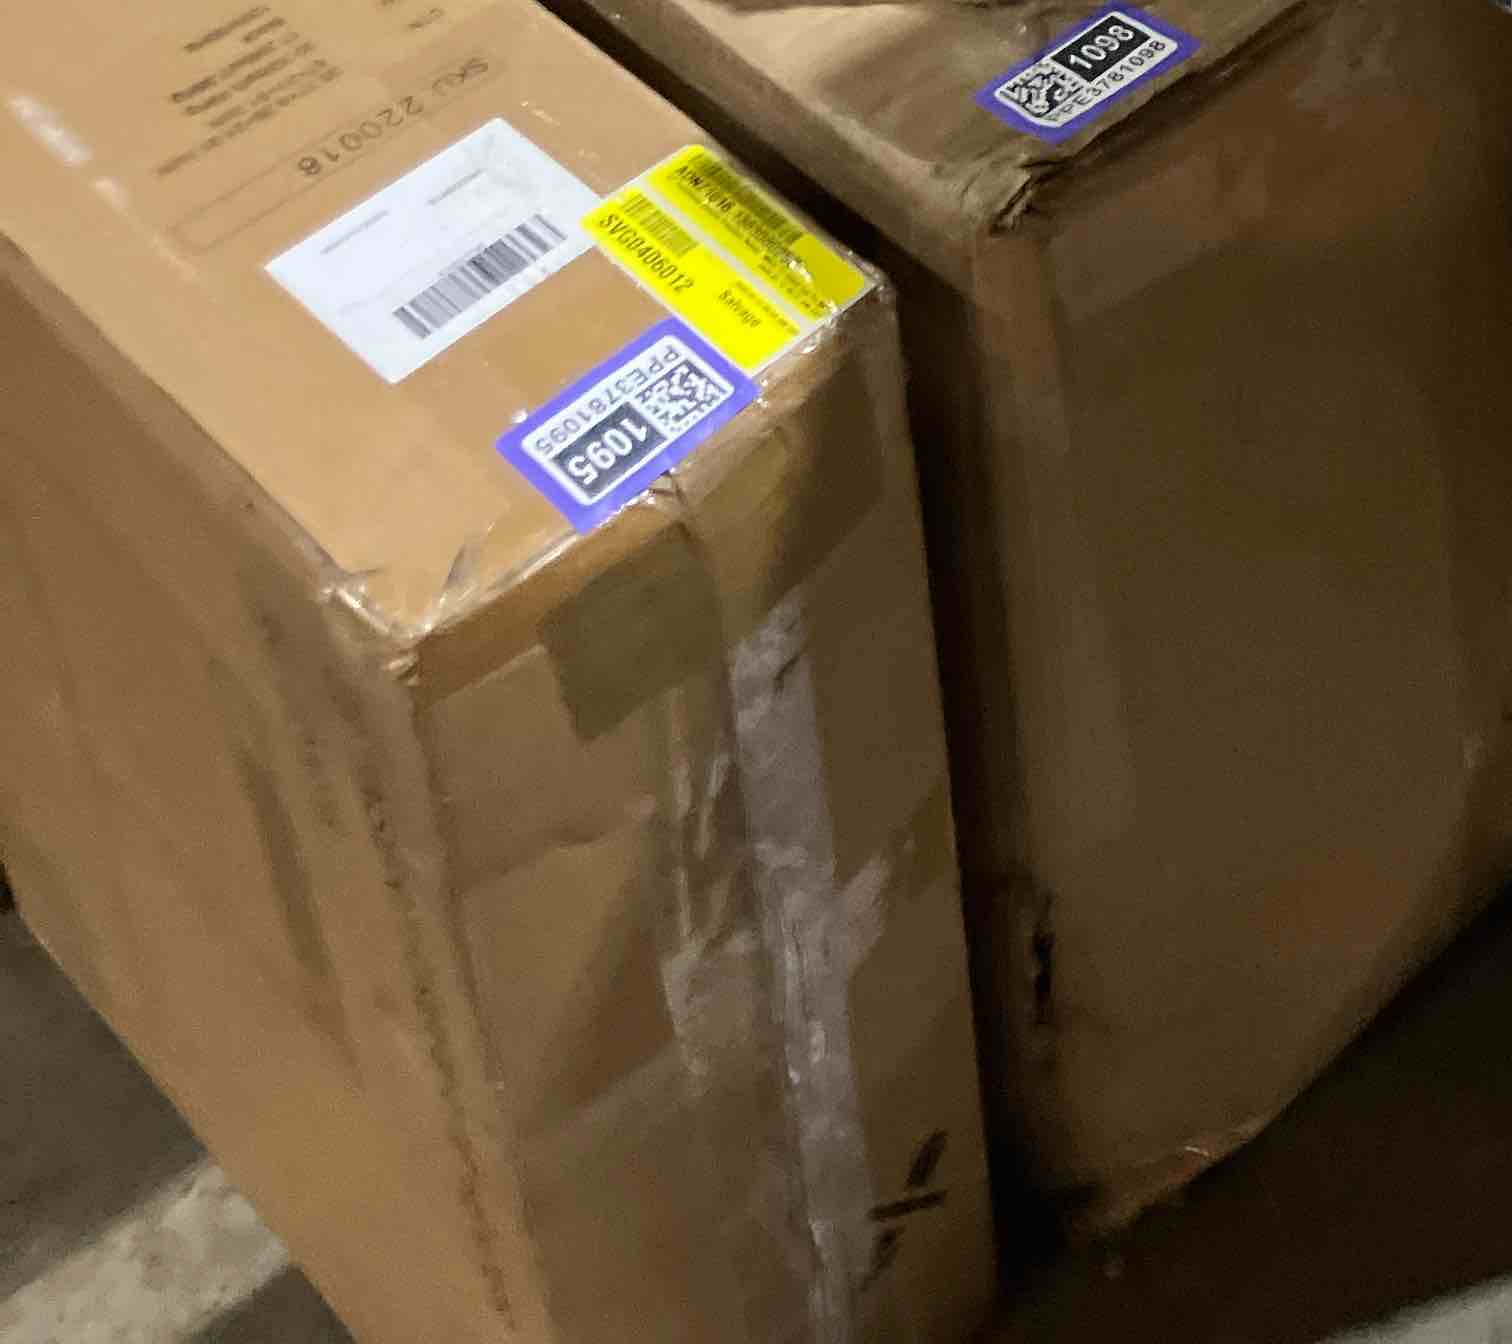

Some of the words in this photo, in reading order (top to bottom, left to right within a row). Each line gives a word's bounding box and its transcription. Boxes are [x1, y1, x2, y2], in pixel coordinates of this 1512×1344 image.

[1043, 40, 1167, 123] PPE3781098
[1068, 23, 1135, 70] 1098
[595, 210, 696, 299] SVG0406012
[533, 346, 683, 460] PPE3781095
[565, 419, 648, 486] 1095
